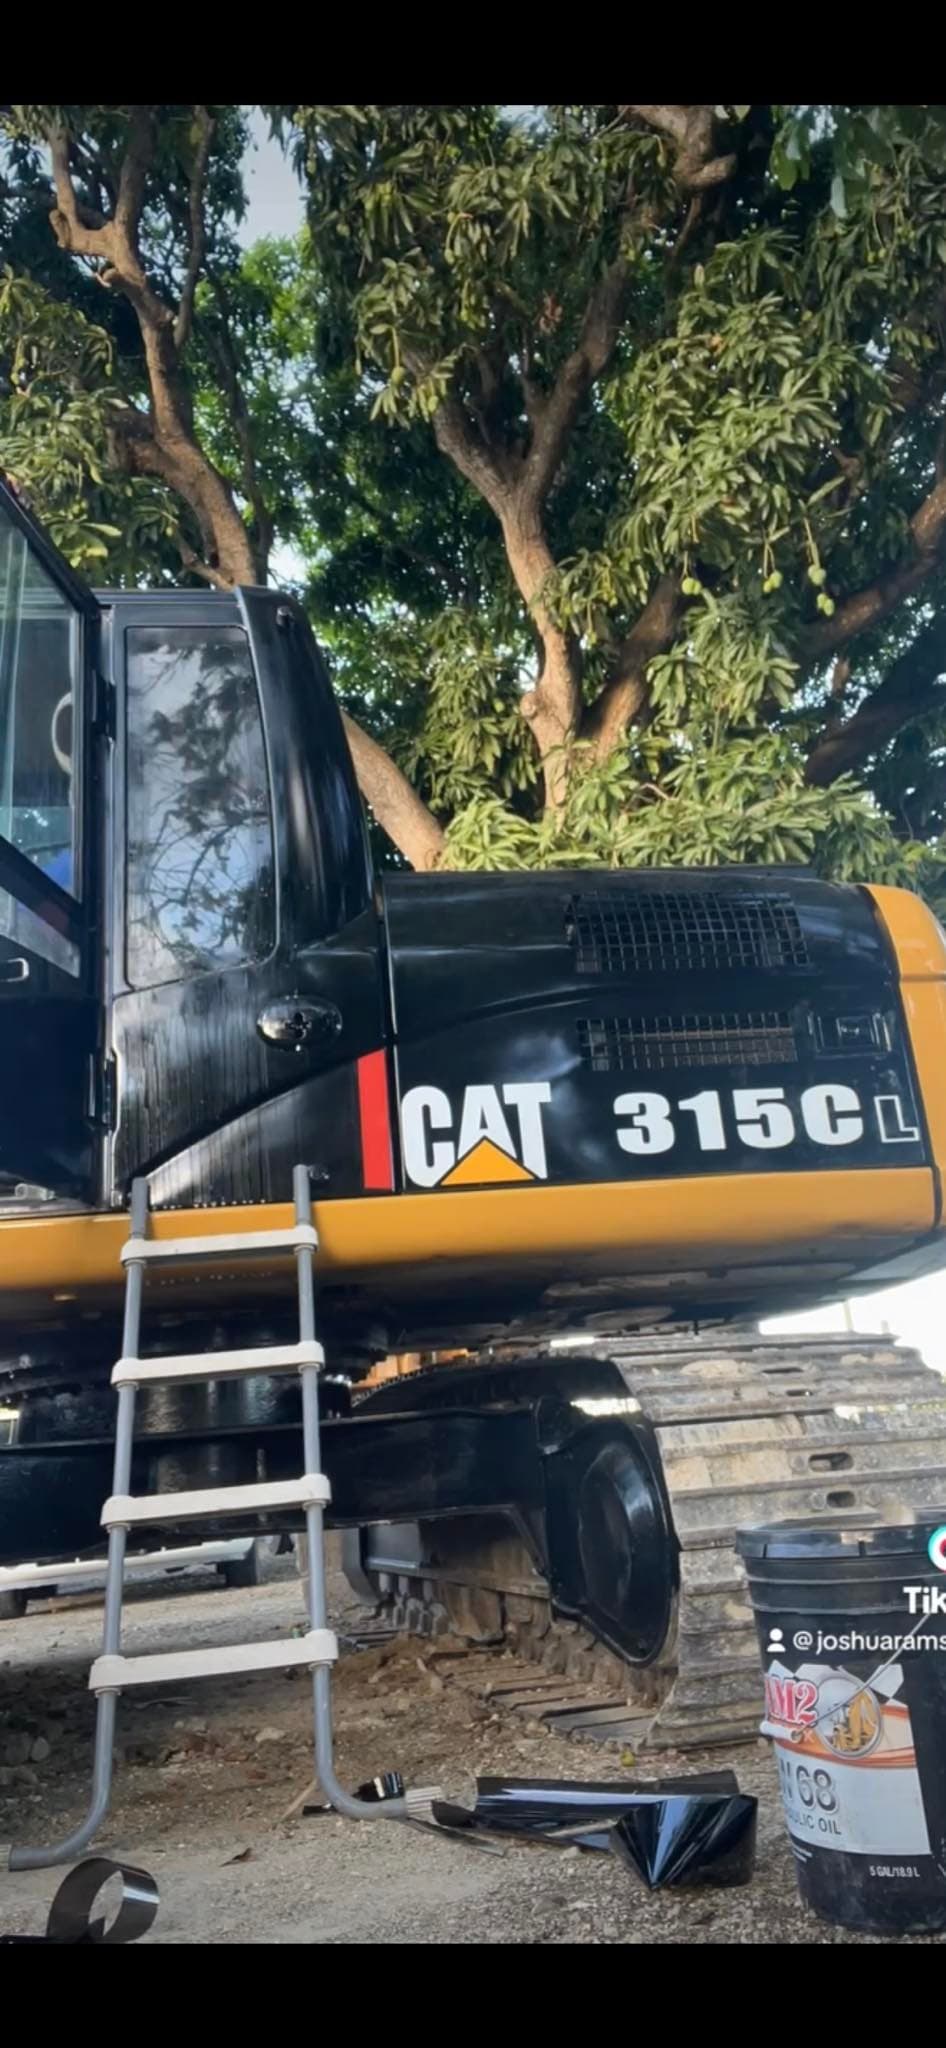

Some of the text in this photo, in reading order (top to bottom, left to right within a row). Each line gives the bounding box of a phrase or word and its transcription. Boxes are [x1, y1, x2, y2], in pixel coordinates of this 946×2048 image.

[400, 1082, 551, 1188] CAT
[613, 1084, 864, 1155] 315C
[796, 1765, 836, 1811] 68
[818, 1817, 842, 1836] OIL
